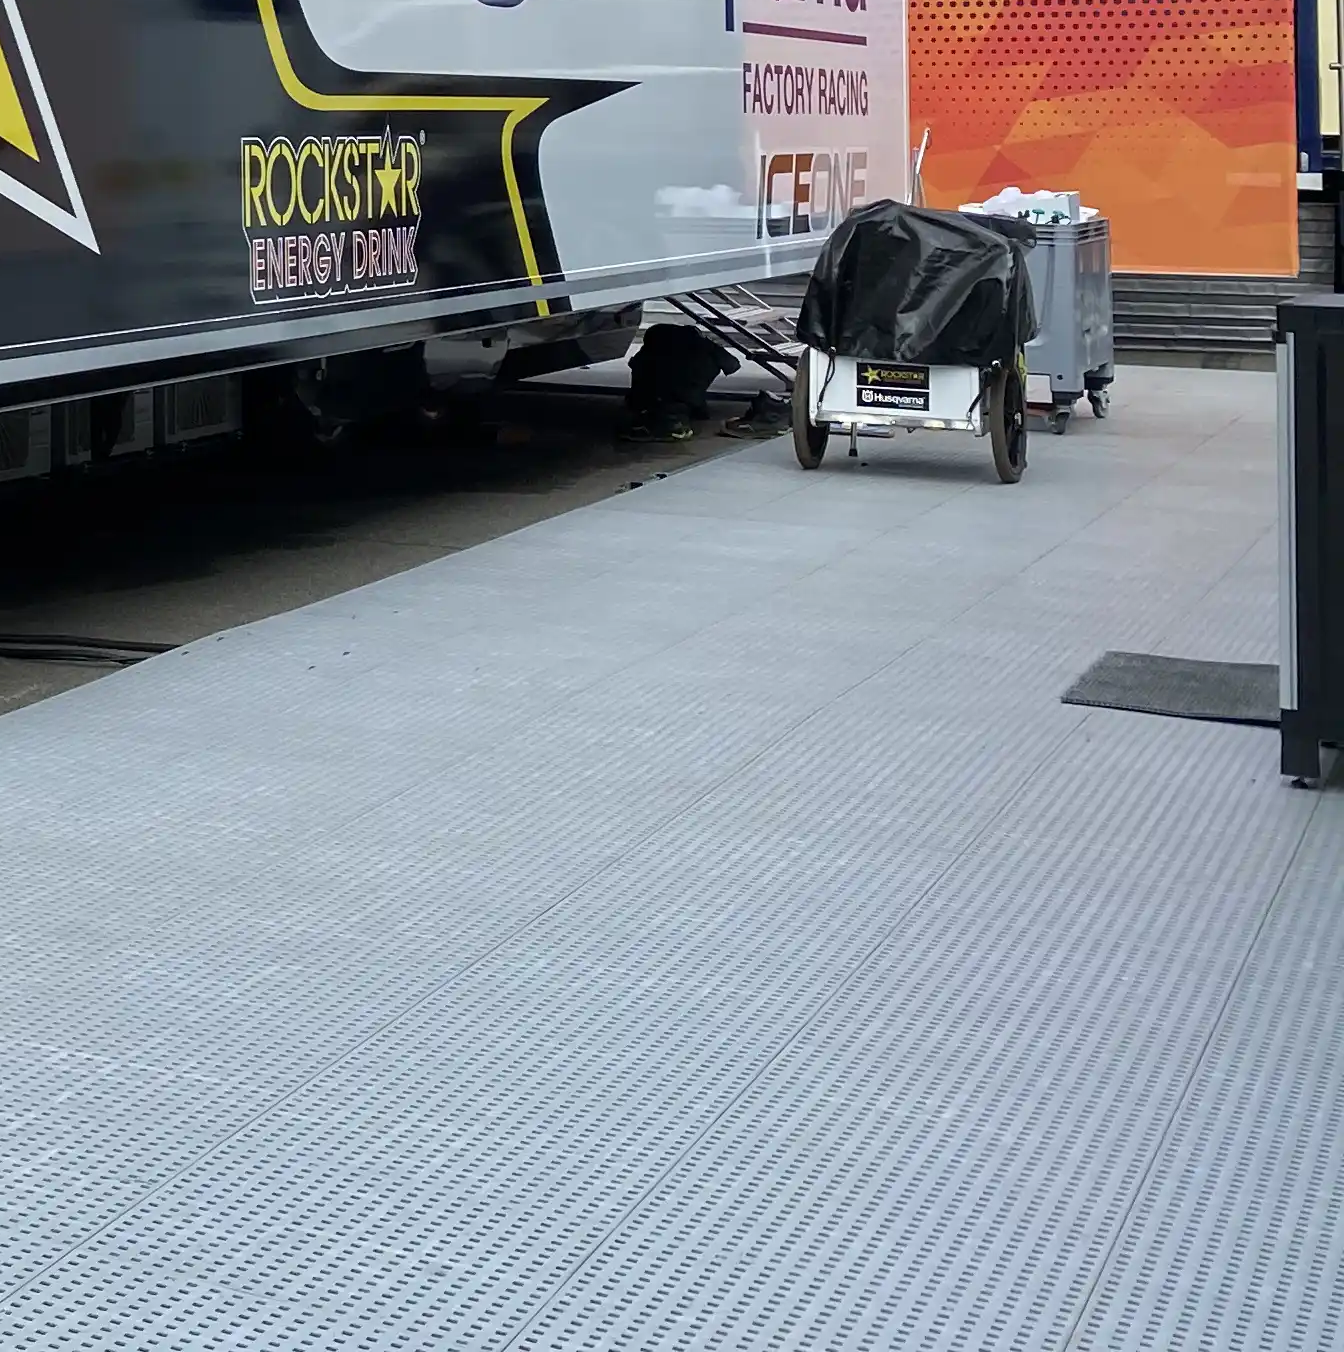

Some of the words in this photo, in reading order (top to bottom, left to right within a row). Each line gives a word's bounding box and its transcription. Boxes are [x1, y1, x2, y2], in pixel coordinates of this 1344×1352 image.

[742, 62, 814, 115] FACTORY
[818, 68, 869, 116] RACING
[252, 232, 346, 291] ENERGY
[352, 225, 416, 280] DRINK
